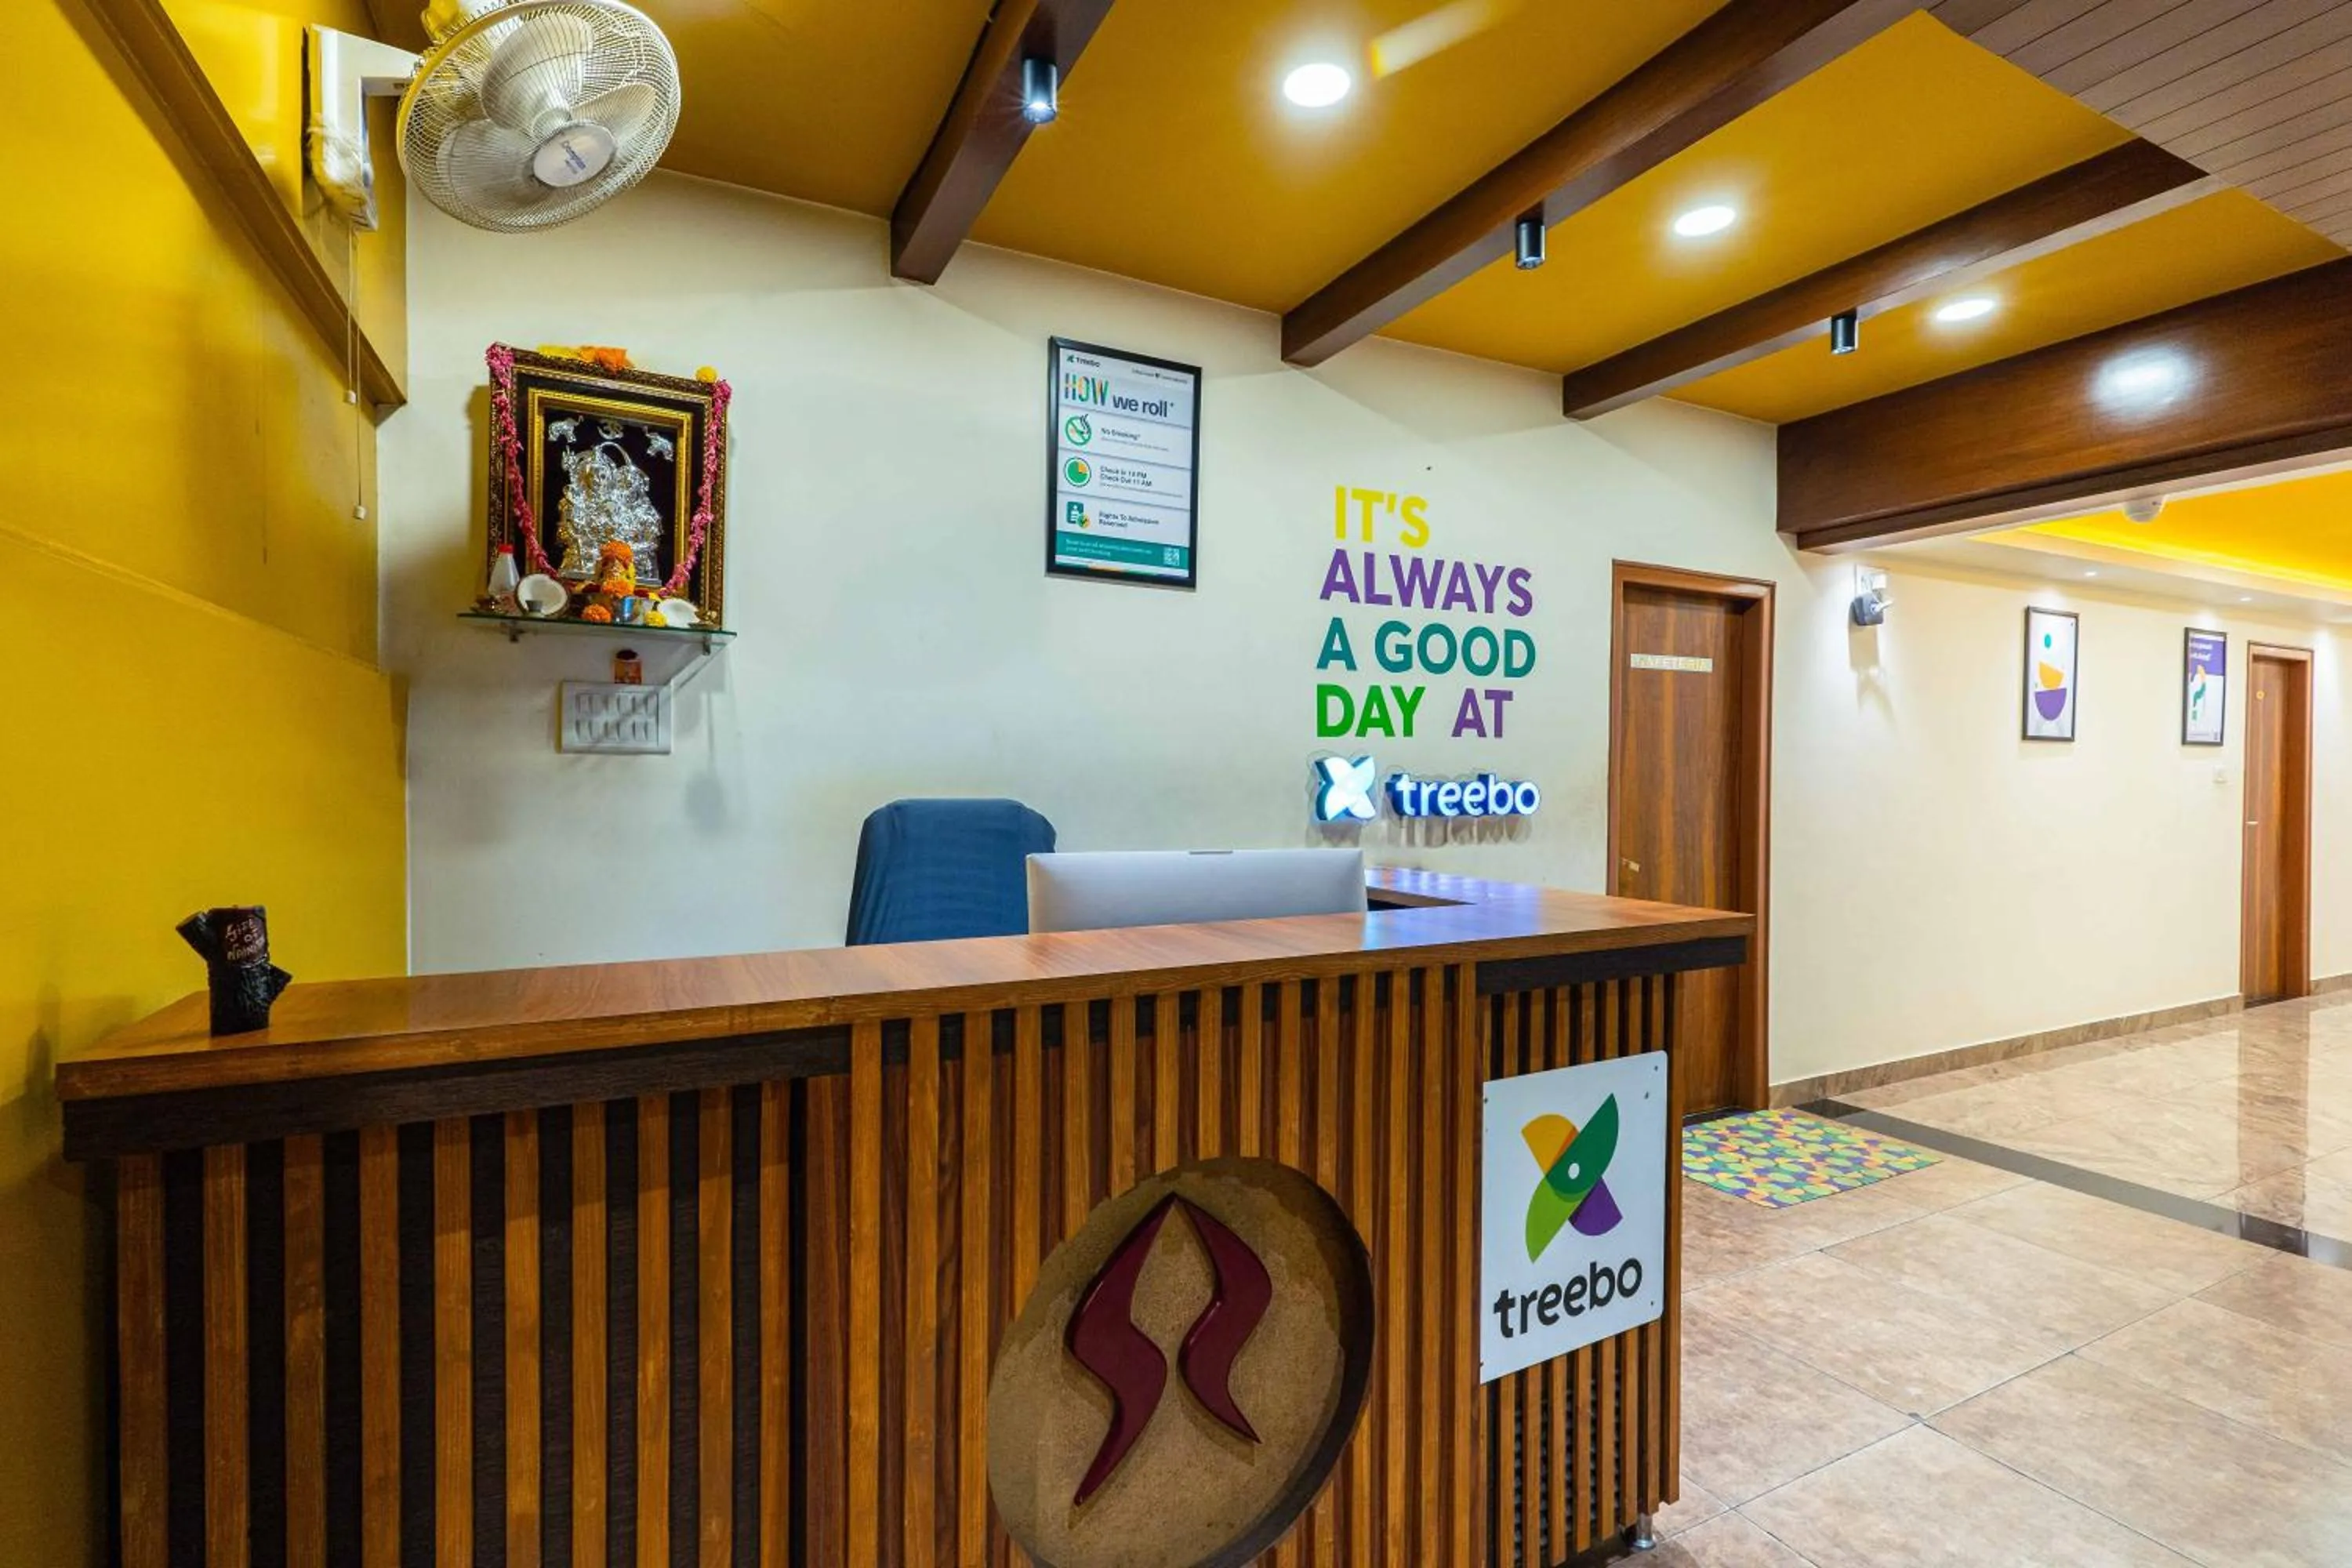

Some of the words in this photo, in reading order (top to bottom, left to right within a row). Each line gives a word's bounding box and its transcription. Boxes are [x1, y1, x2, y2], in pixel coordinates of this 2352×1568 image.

[1064, 372, 1109, 406] HOW
[1112, 394, 1139, 412] we
[1334, 485, 1430, 548] IT'S
[1319, 548, 1533, 617] ALWAYS
[1316, 616, 1357, 672] A
[1374, 619, 1537, 679] GOOD
[1316, 684, 1426, 738] DAY
[1450, 688, 1513, 739] AT
[1387, 772, 1541, 818] treebo
[1494, 1257, 1643, 1338] treebo
